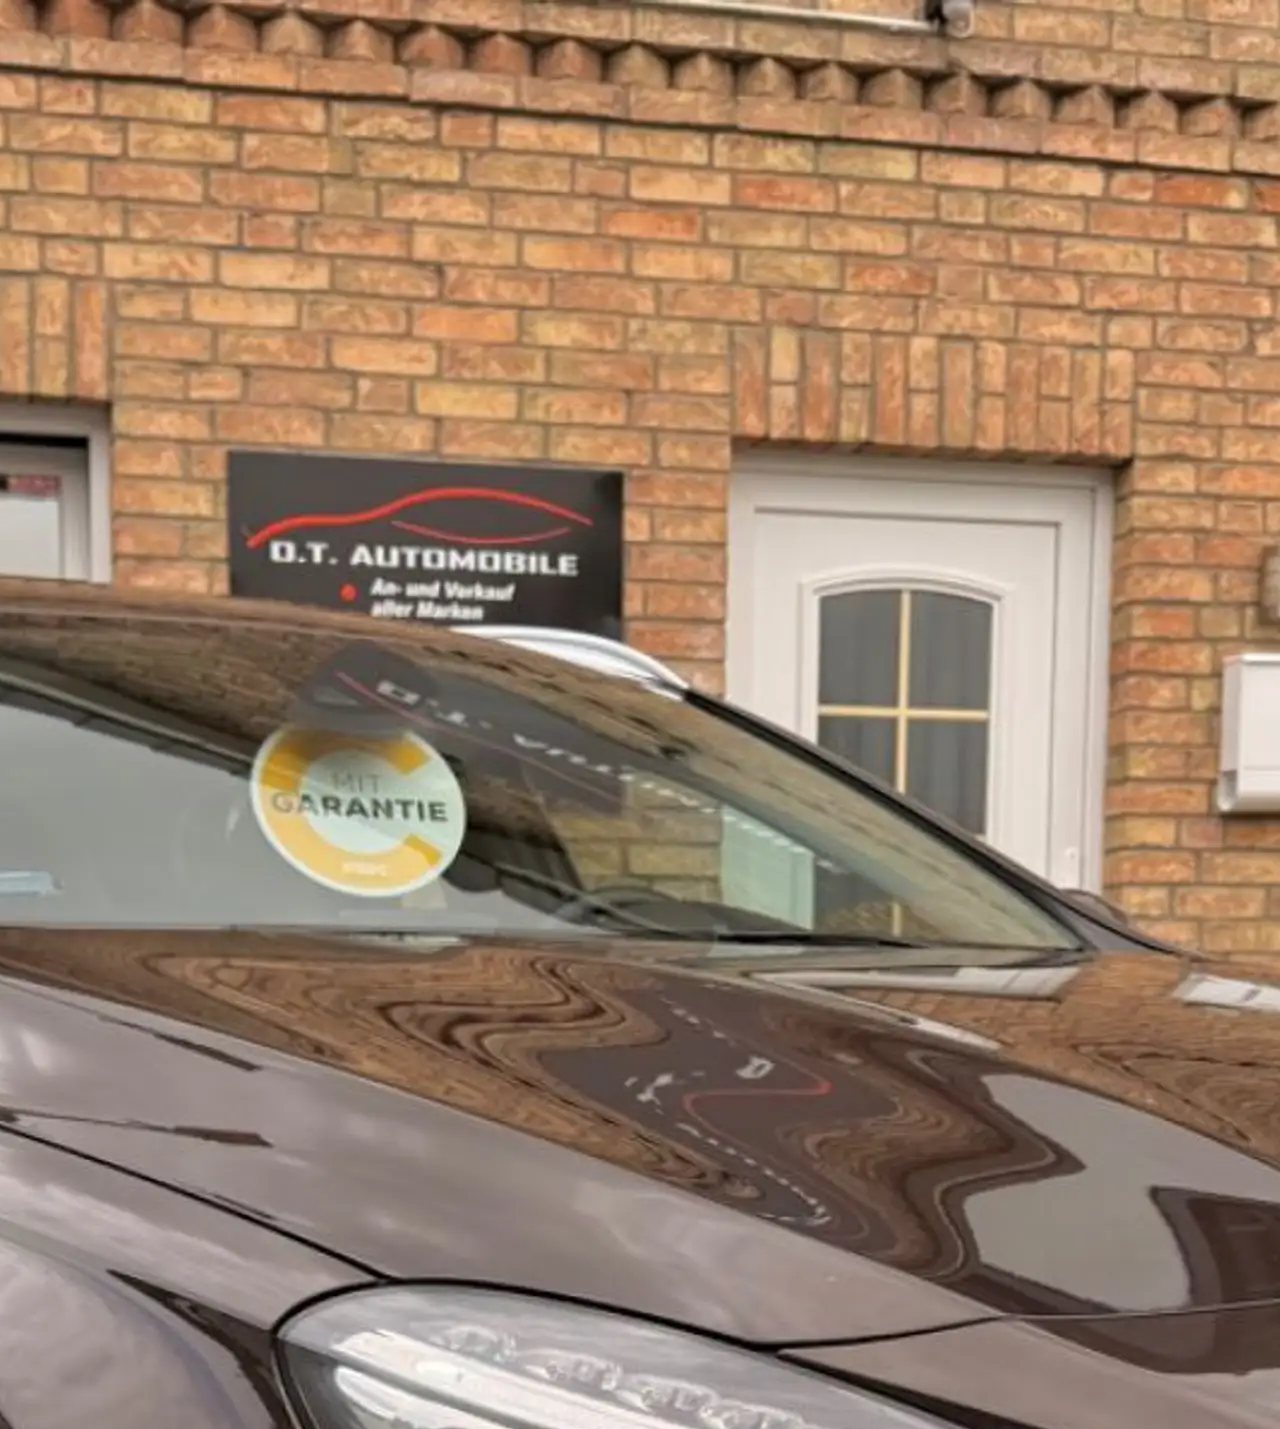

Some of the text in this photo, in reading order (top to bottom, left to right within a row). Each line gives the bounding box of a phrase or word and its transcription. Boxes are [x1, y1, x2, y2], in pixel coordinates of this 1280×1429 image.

[269, 539, 580, 577] O.T. AUTOMOBILE
[370, 577, 516, 602] An- und Verkauf
[370, 600, 485, 621] aller Marken
[330, 770, 382, 794] MIT
[272, 791, 449, 823] GARANTIE
